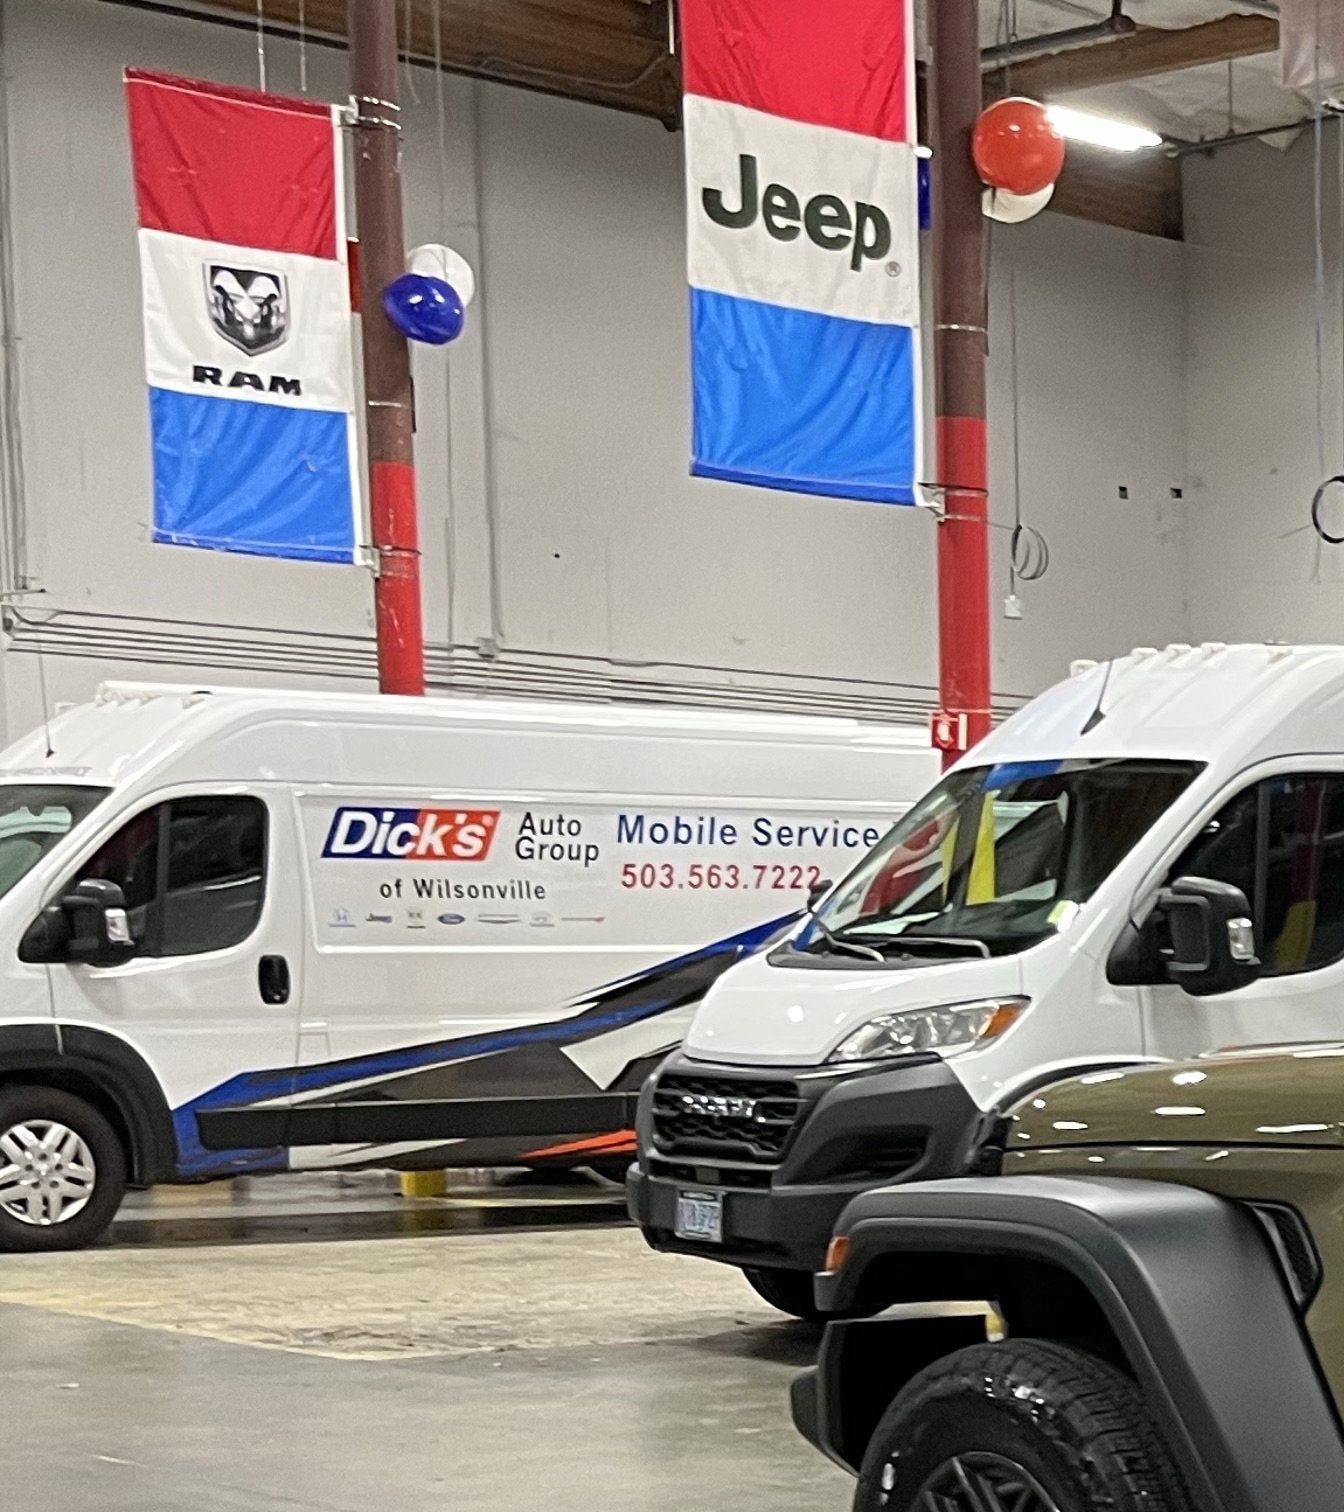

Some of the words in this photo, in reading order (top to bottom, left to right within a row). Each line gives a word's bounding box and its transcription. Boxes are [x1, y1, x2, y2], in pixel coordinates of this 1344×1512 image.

[702, 153, 891, 272] Jeep
[193, 365, 301, 396] RAM
[330, 810, 487, 857] Dick's
[518, 812, 582, 837] Auto
[617, 814, 738, 845] Mobile
[752, 817, 879, 847] Service
[515, 836, 599, 867] Group
[380, 878, 402, 899] of
[413, 878, 546, 899] Wilsonville
[621, 863, 821, 889] 503.563.7222
